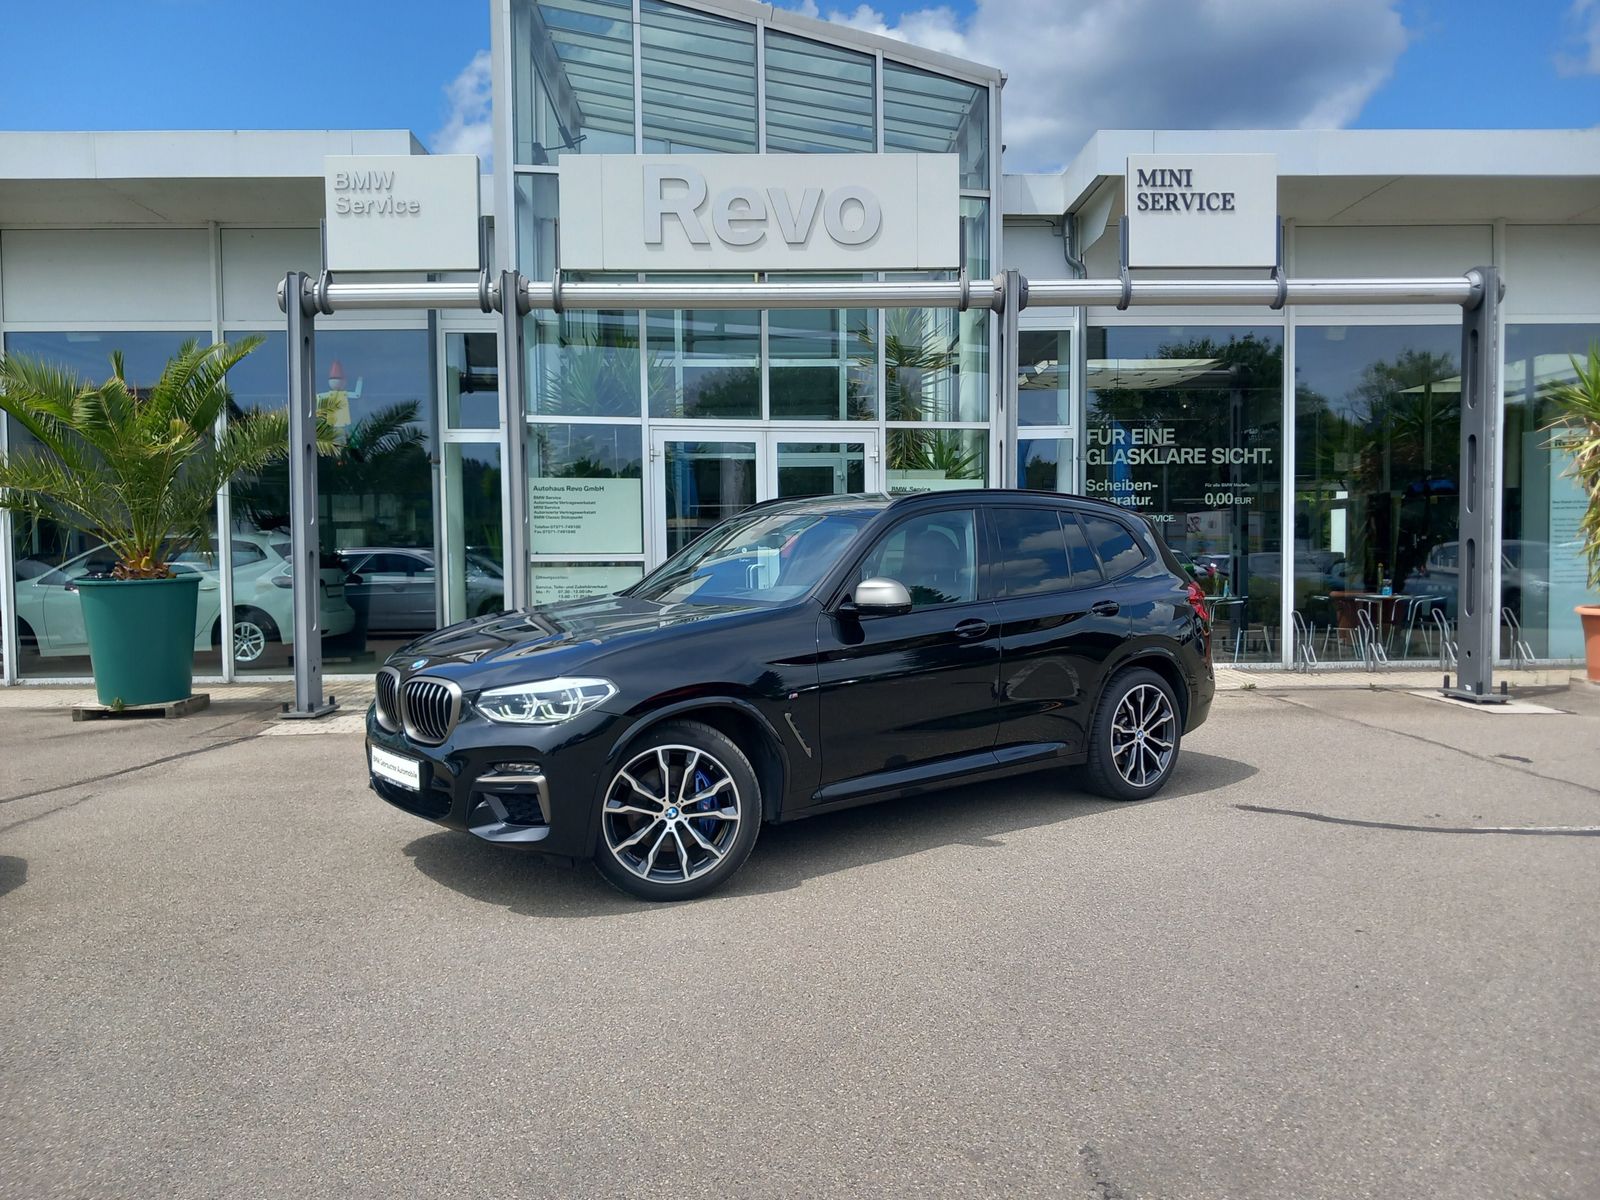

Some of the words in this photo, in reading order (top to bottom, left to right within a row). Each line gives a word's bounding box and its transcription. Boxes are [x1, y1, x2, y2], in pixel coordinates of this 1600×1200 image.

[334, 170, 395, 191] BMW
[1137, 168, 1193, 188] MINI
[335, 195, 421, 215] Service
[642, 163, 884, 247] Revo
[1137, 192, 1236, 212] SERVICE
[1086, 425, 1126, 446] FÜR
[1131, 427, 1176, 445] EINE
[1086, 447, 1207, 466] GLASKLARE
[1211, 447, 1273, 465] SICHT.
[1086, 478, 1159, 492] Scheiben-
[1204, 492, 1234, 508] 0,00
